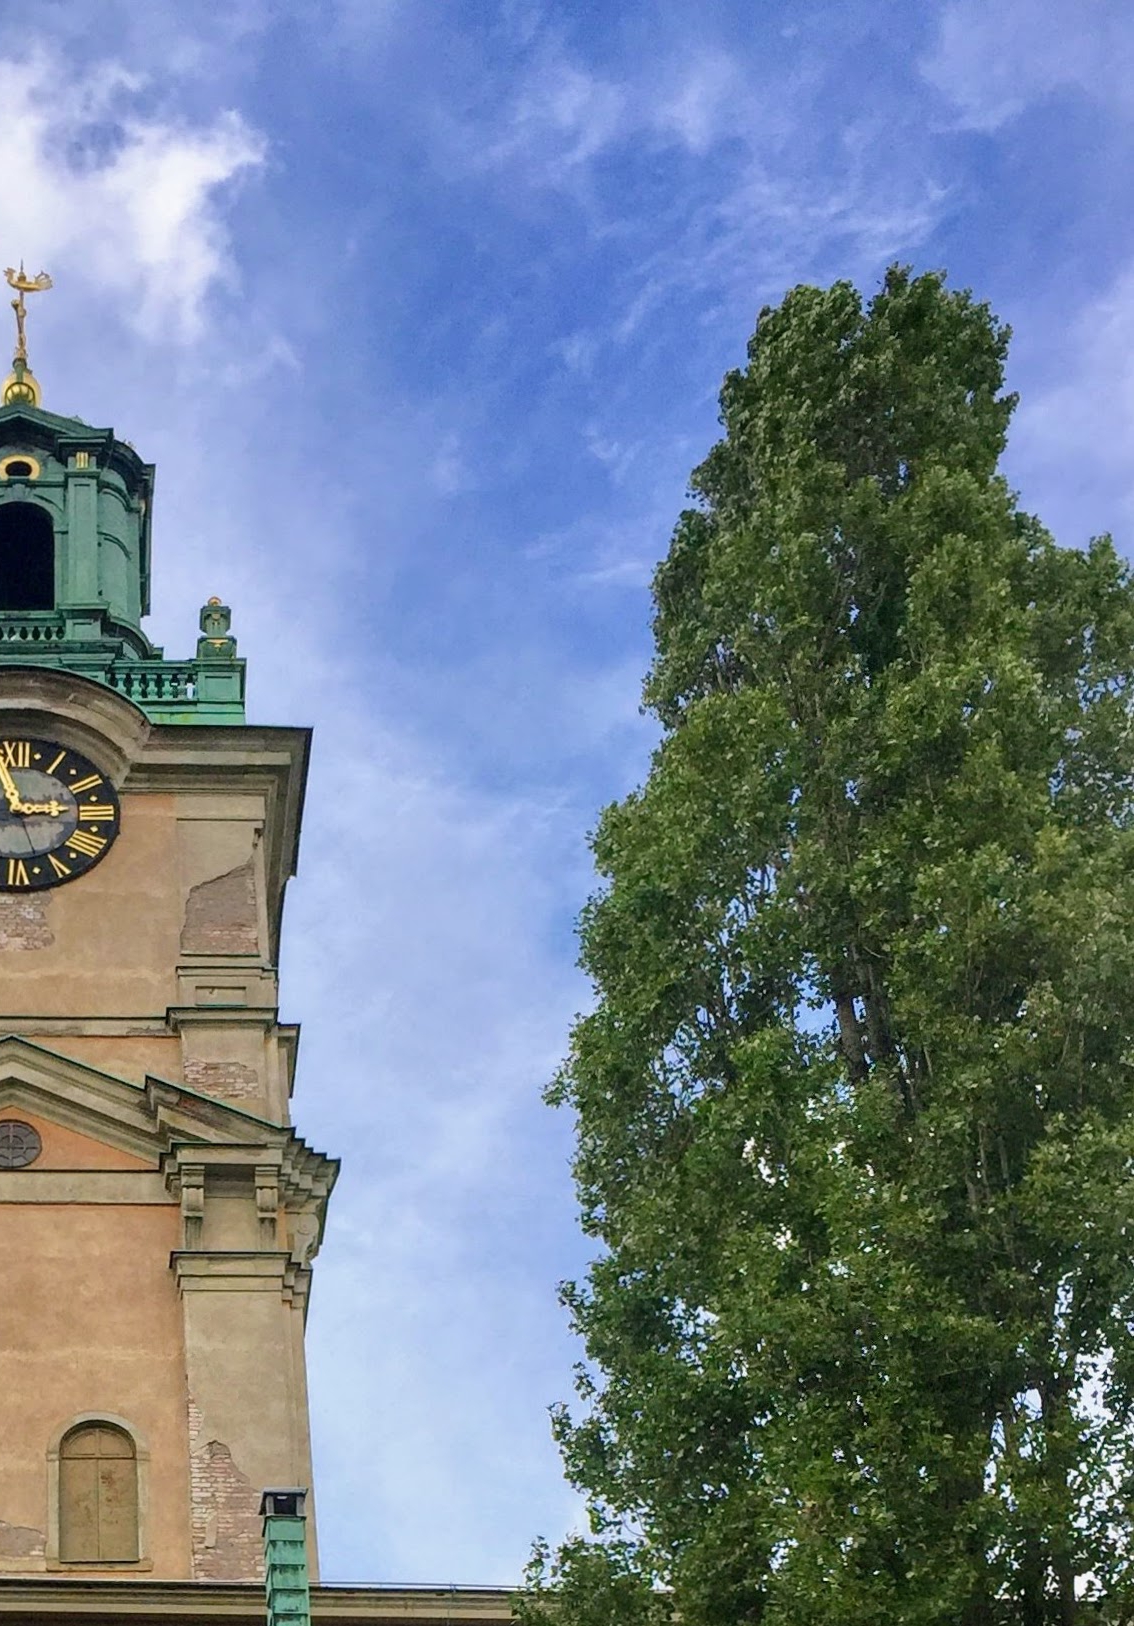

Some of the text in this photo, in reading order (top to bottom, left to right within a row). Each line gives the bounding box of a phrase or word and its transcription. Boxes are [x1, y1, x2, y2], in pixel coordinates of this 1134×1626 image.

[3, 741, 30, 767] XII
[46, 751, 66, 774] I
[68, 774, 103, 794] II
[79, 805, 114, 821] III
[8, 859, 30, 886] VI
[47, 853, 72, 878] V
